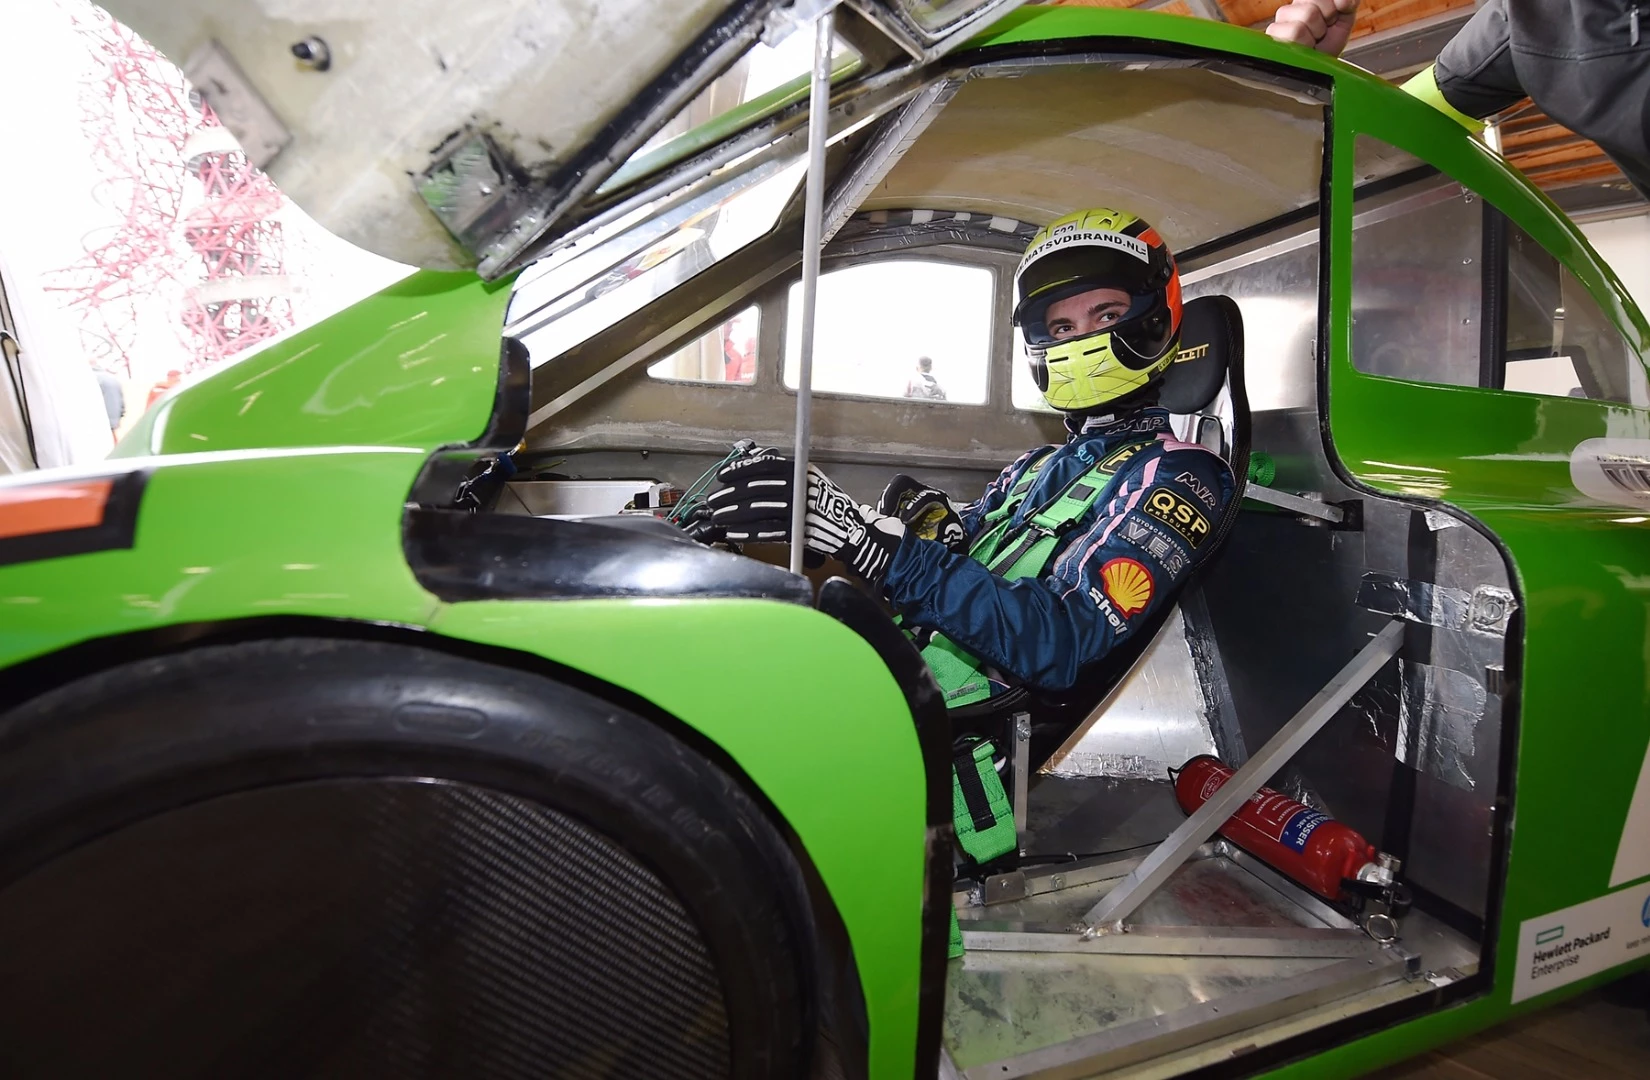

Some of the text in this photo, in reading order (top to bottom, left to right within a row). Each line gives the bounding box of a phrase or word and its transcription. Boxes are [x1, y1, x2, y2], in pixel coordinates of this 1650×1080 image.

[1147, 508, 1196, 543] PRODUCTS
[1152, 493, 1208, 534] QSP
[1128, 521, 1183, 575] VES
[1088, 586, 1128, 635] Shell
[1532, 926, 1611, 965] Hewlett Packard
[1531, 954, 1580, 980] Enterprise
